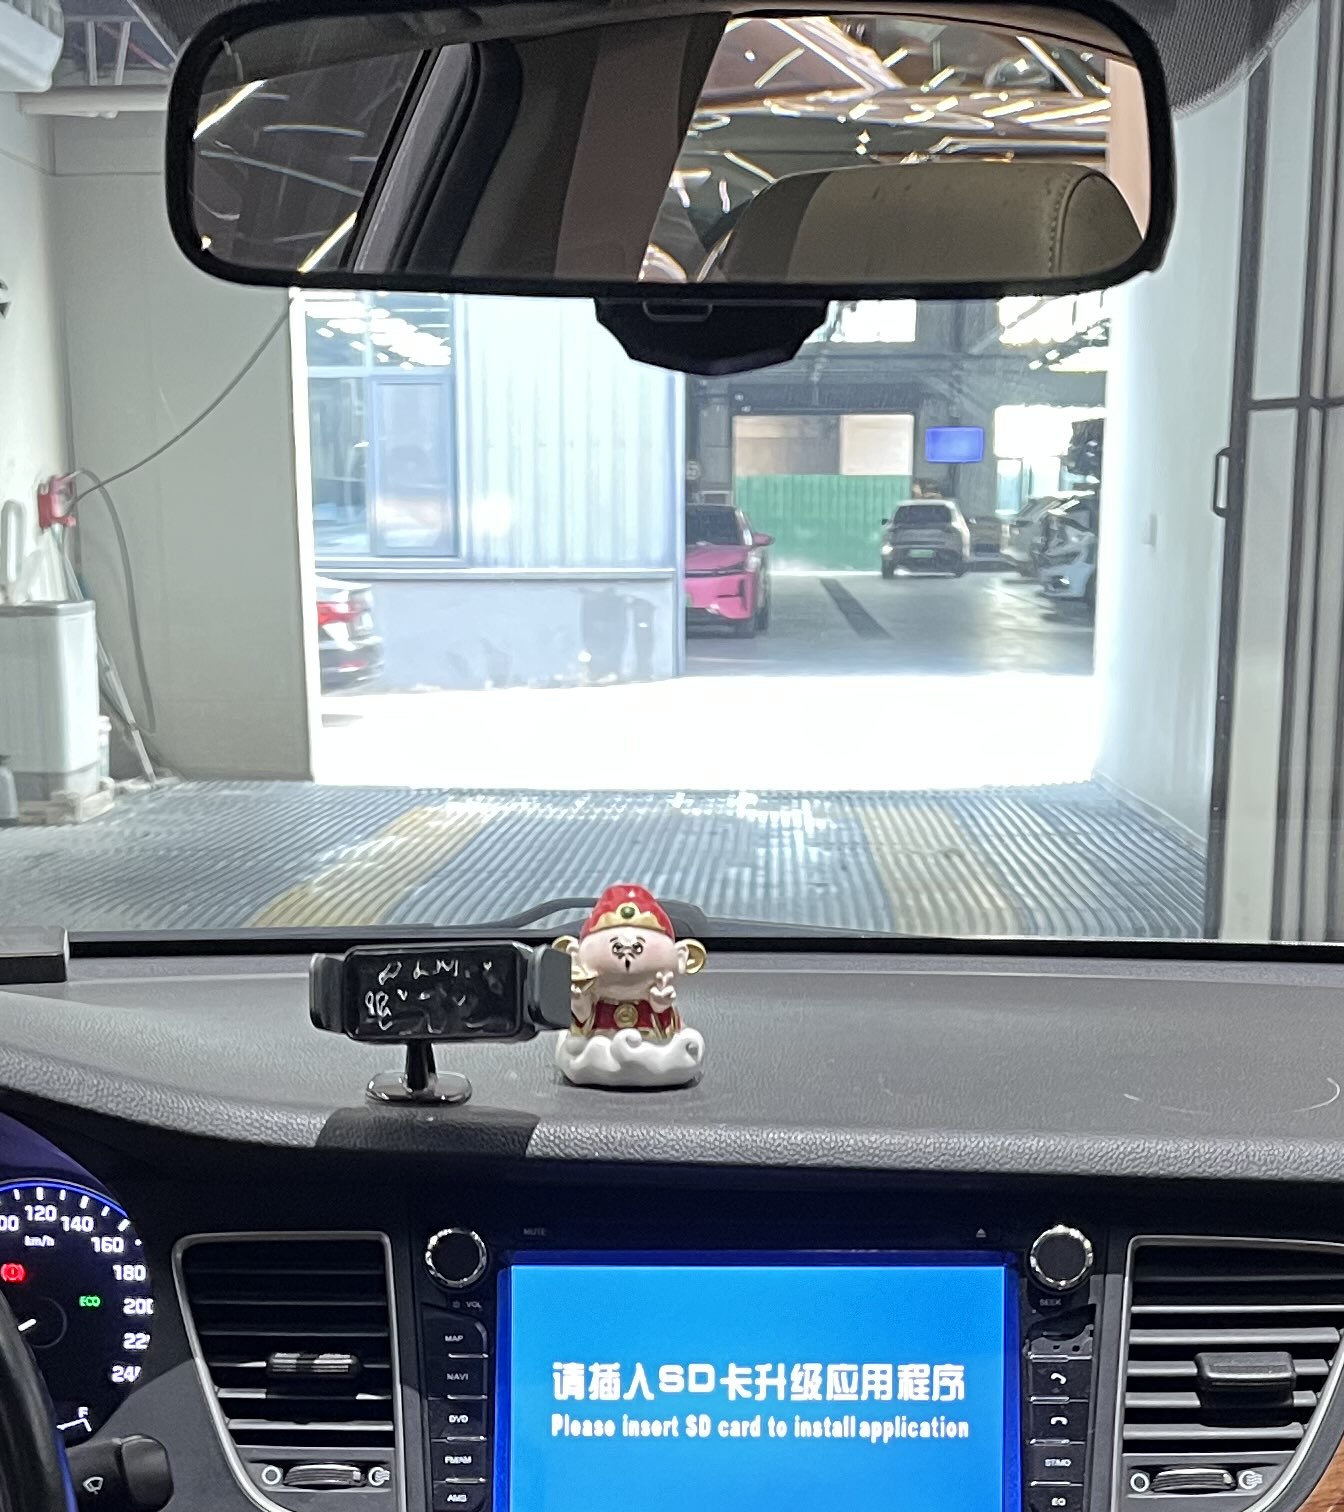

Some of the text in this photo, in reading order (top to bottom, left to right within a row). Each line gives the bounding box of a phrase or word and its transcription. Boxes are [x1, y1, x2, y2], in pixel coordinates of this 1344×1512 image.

[24, 1204, 57, 1222] 120
[60, 1215, 94, 1233] 140
[24, 1235, 55, 1247] km/h
[90, 1236, 125, 1253] 160
[112, 1264, 147, 1281] 180
[79, 1295, 101, 1307] ECO
[123, 1332, 151, 1349] 22
[77, 1406, 89, 1419] F
[448, 1414, 469, 1423] DVD
[551, 1413, 969, 1443] Please insert SD card to install application
